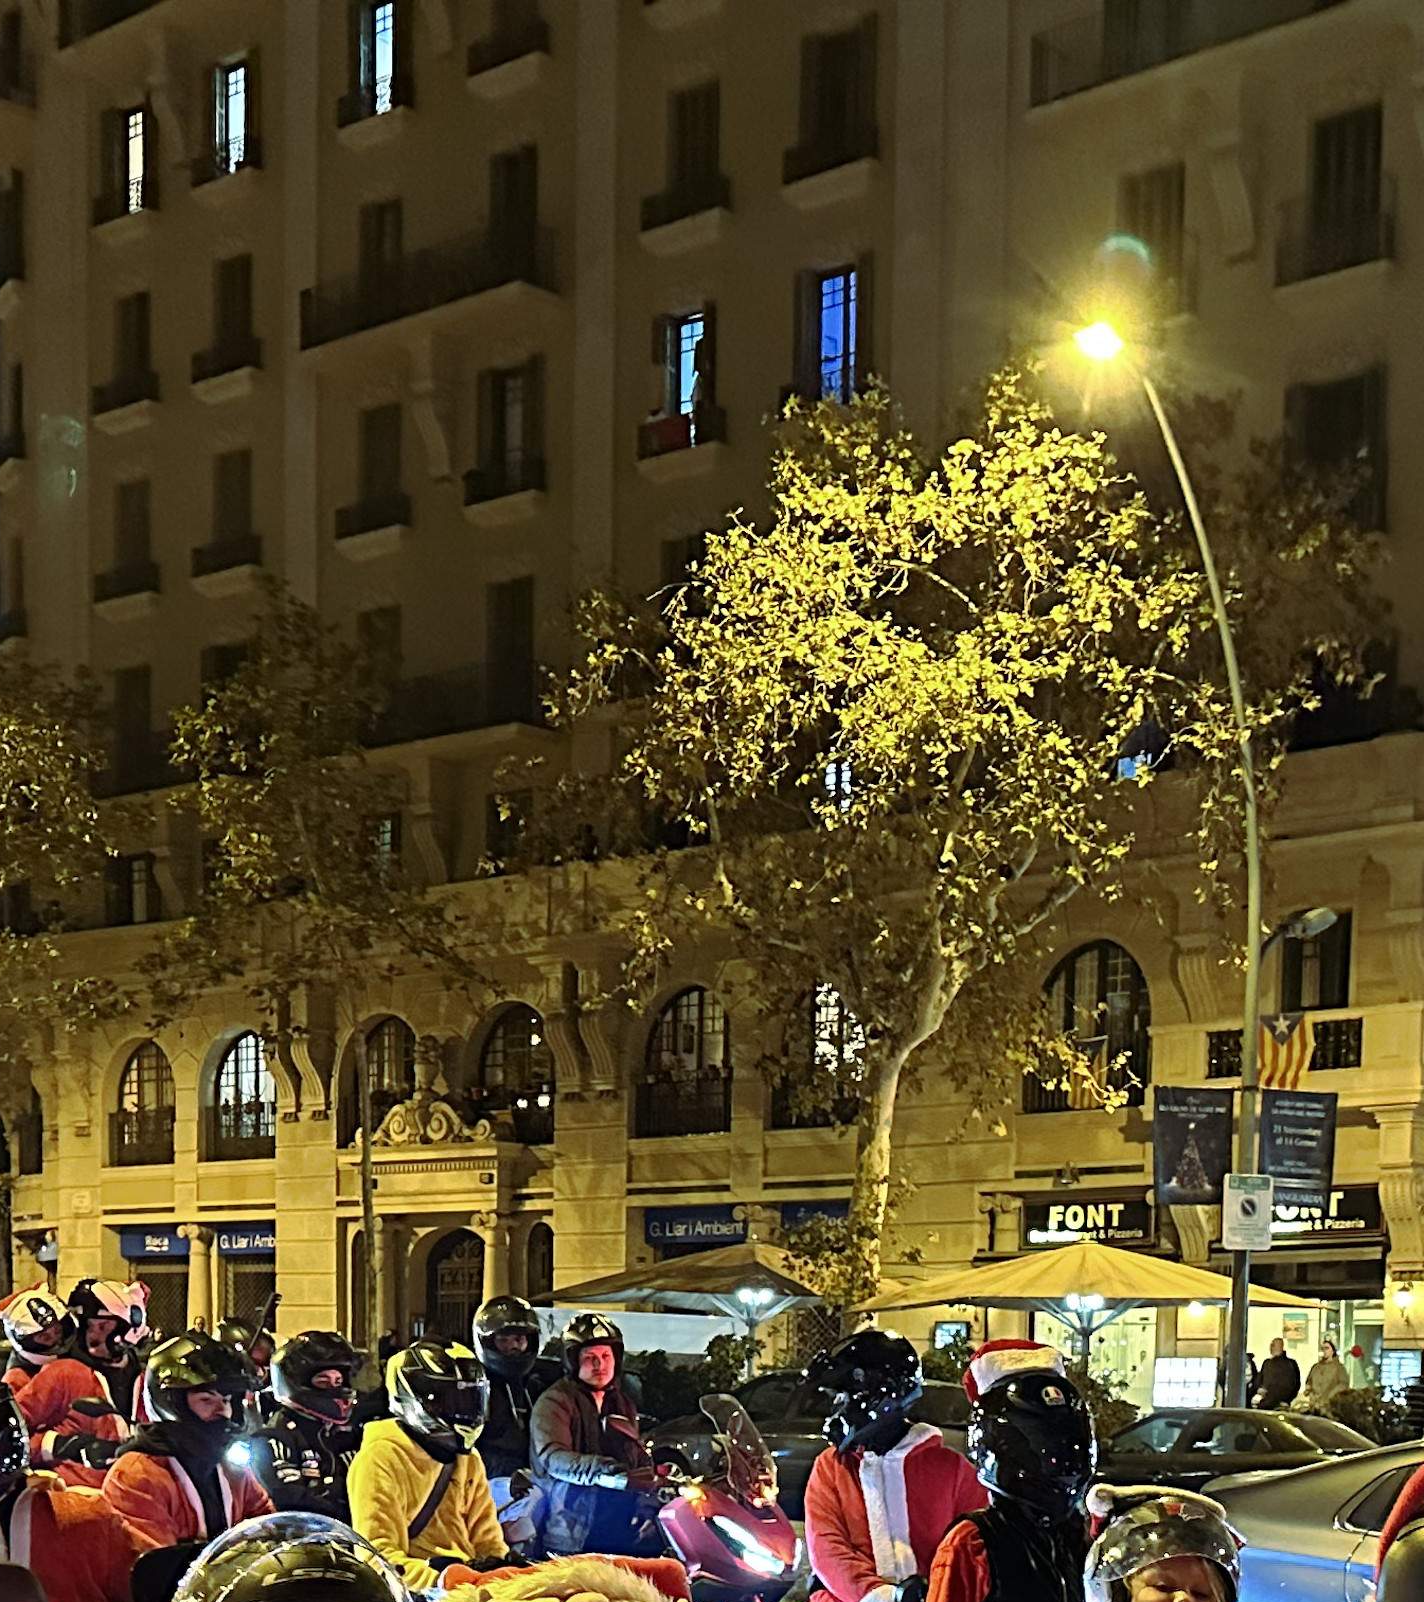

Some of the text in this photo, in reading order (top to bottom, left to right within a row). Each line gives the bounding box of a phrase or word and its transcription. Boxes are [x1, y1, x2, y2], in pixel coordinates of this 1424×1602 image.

[1048, 1203, 1125, 1231] FONT
[1324, 1217, 1366, 1230] Pizzeria
[649, 1223, 663, 1238] G.
[694, 1219, 745, 1236] Ambient
[1108, 1227, 1144, 1240] Pizzeria
